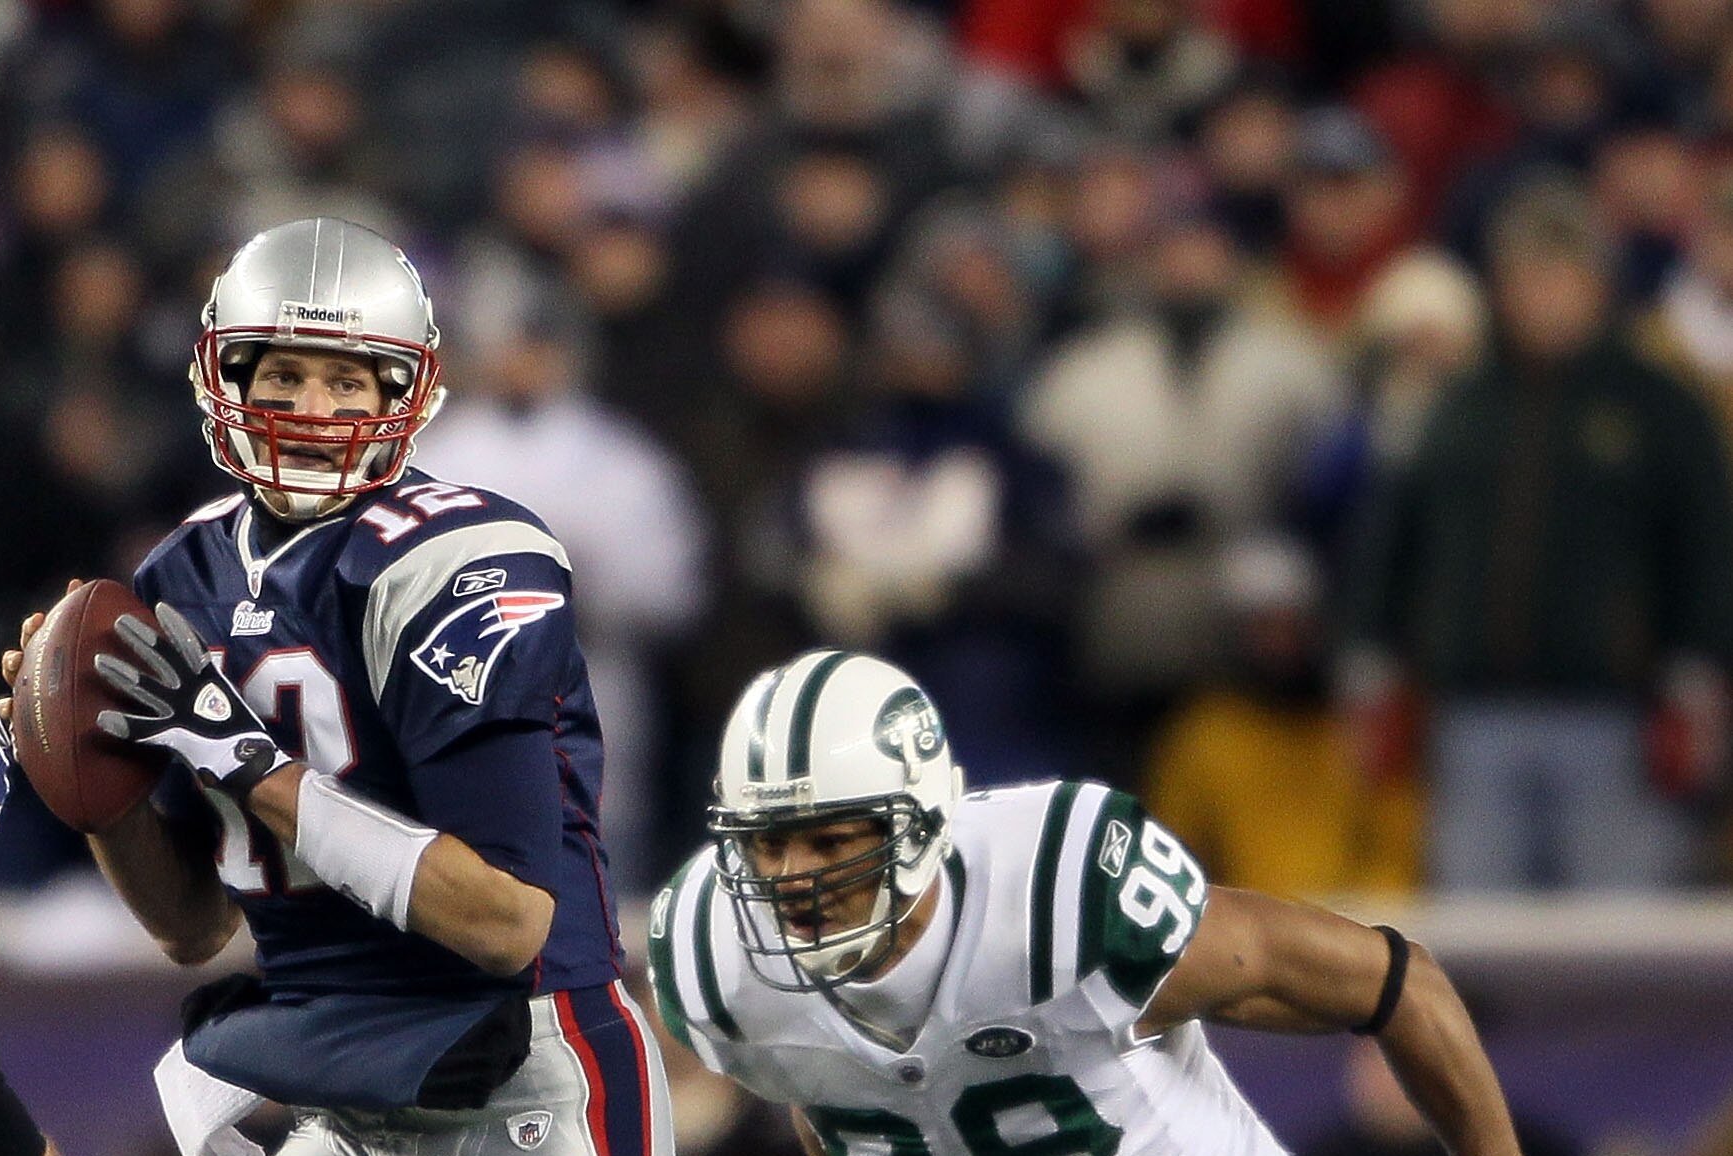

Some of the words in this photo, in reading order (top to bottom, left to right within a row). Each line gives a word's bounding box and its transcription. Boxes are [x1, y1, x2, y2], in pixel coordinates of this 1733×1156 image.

[296, 306, 344, 324] Riddell
[354, 482, 488, 546] 12
[1114, 820, 1209, 956] 99
